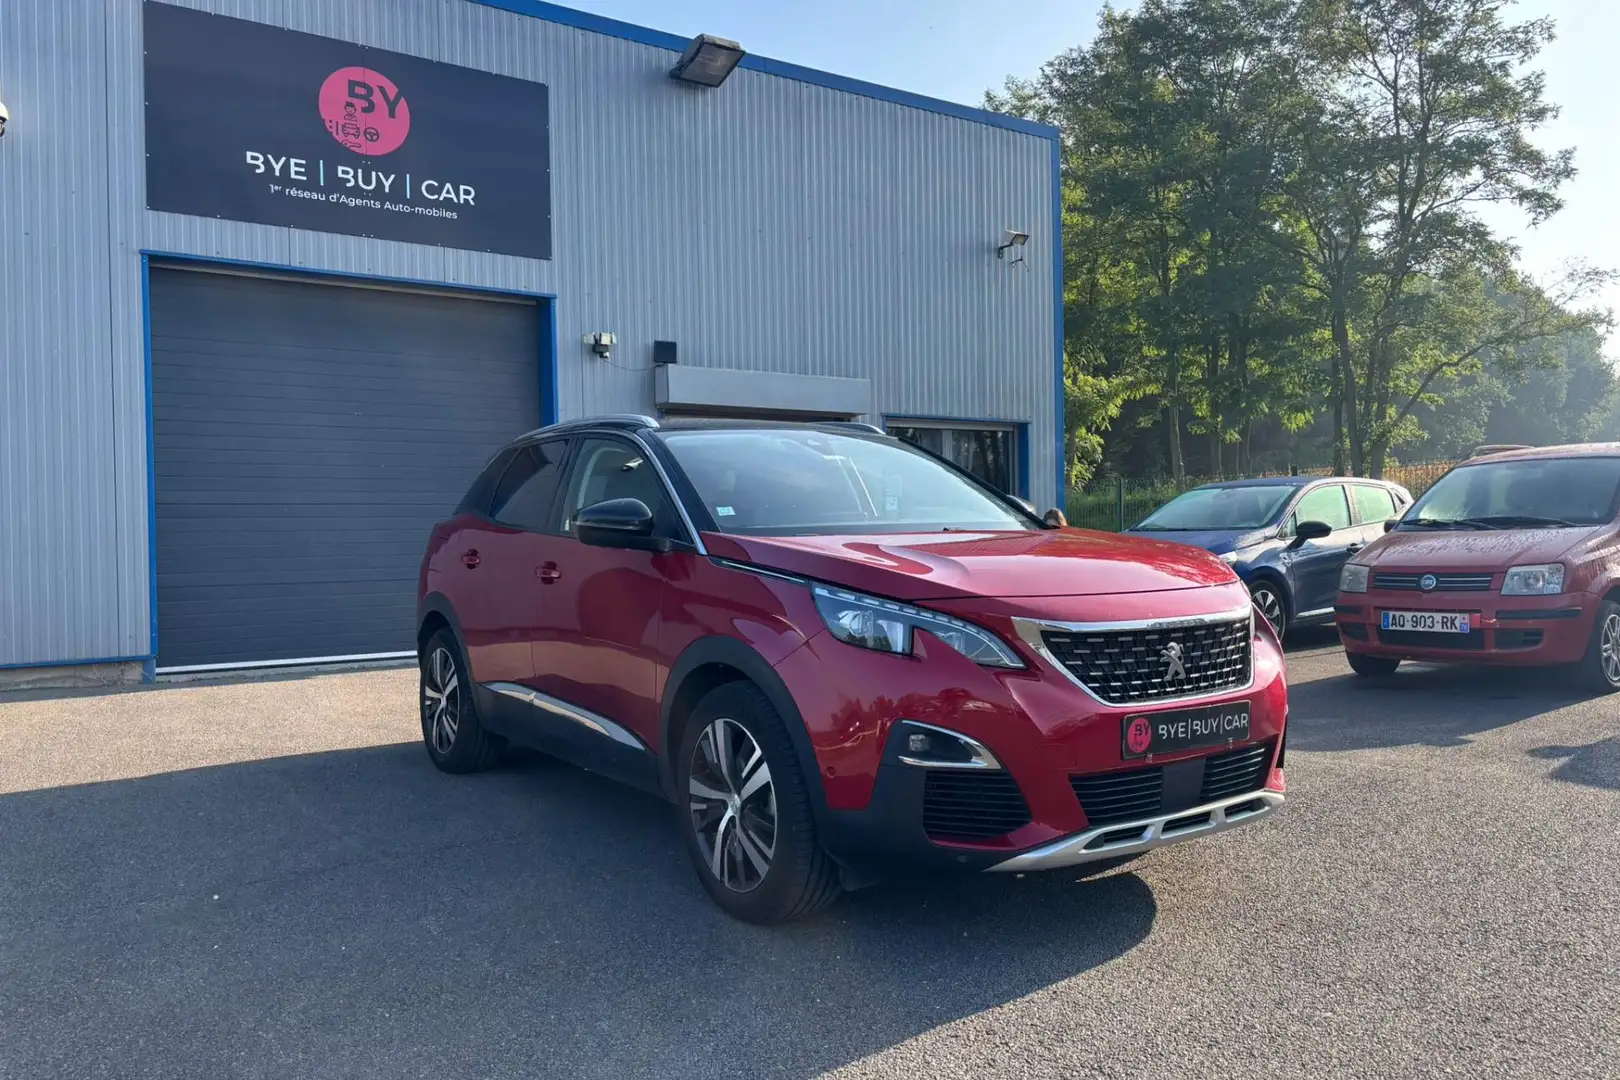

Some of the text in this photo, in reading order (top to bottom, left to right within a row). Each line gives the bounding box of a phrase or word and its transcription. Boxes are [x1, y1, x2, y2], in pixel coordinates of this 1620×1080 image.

[347, 79, 403, 119] BY
[246, 151, 476, 206] BYE BUY CAR
[285, 188, 326, 200] réseau
[329, 193, 381, 209] d'Agents
[383, 202, 457, 219] Auto-mobiles
[1134, 723, 1149, 737] BY
